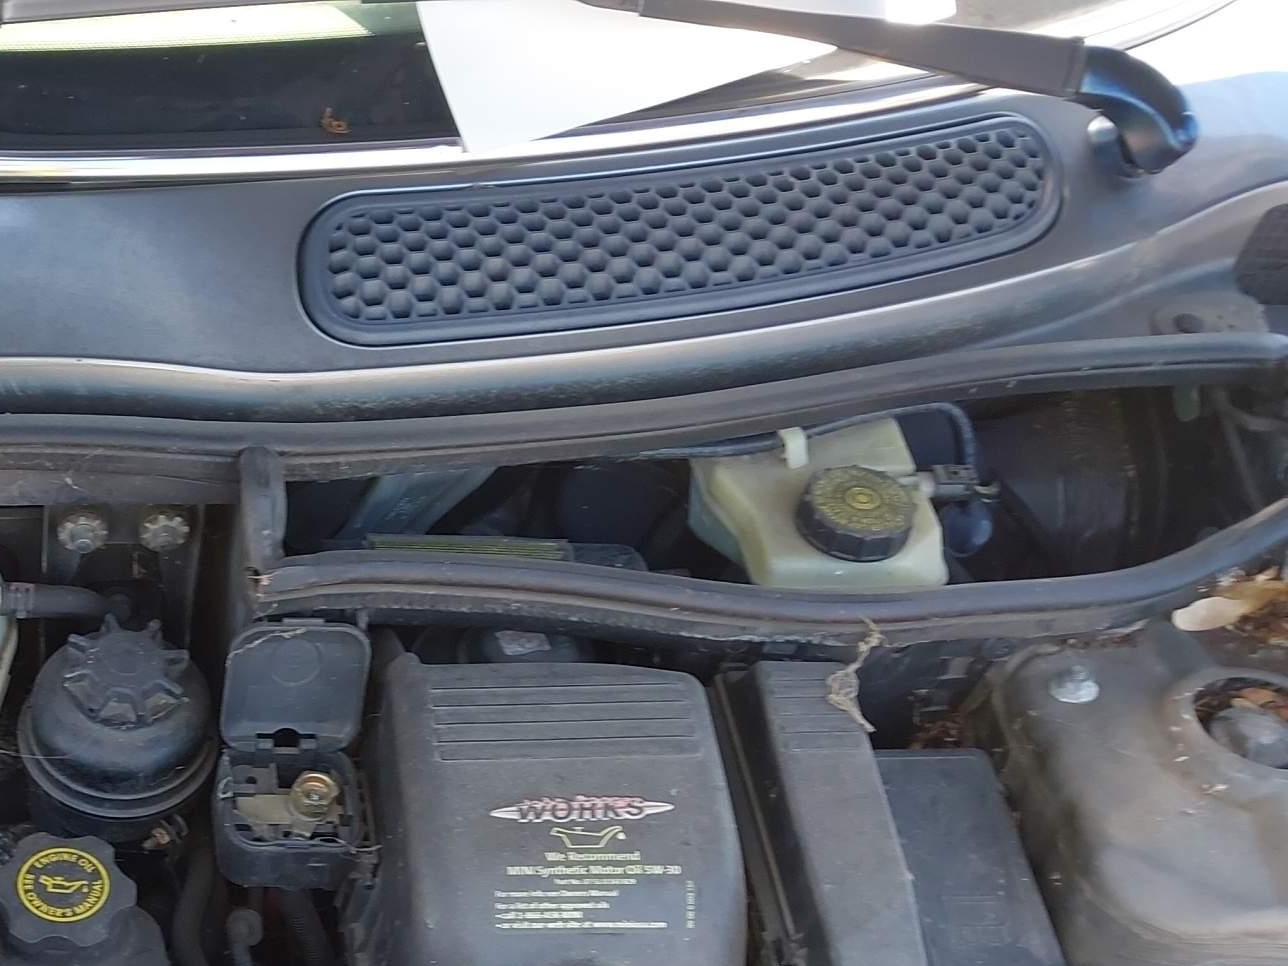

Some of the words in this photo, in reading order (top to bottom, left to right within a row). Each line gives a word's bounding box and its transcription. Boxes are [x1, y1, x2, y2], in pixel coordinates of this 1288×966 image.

[517, 800, 644, 822] WORKS
[33, 853, 79, 869] ENGINE
[79, 858, 97, 873] OIL
[74, 879, 104, 915] MANUAL
